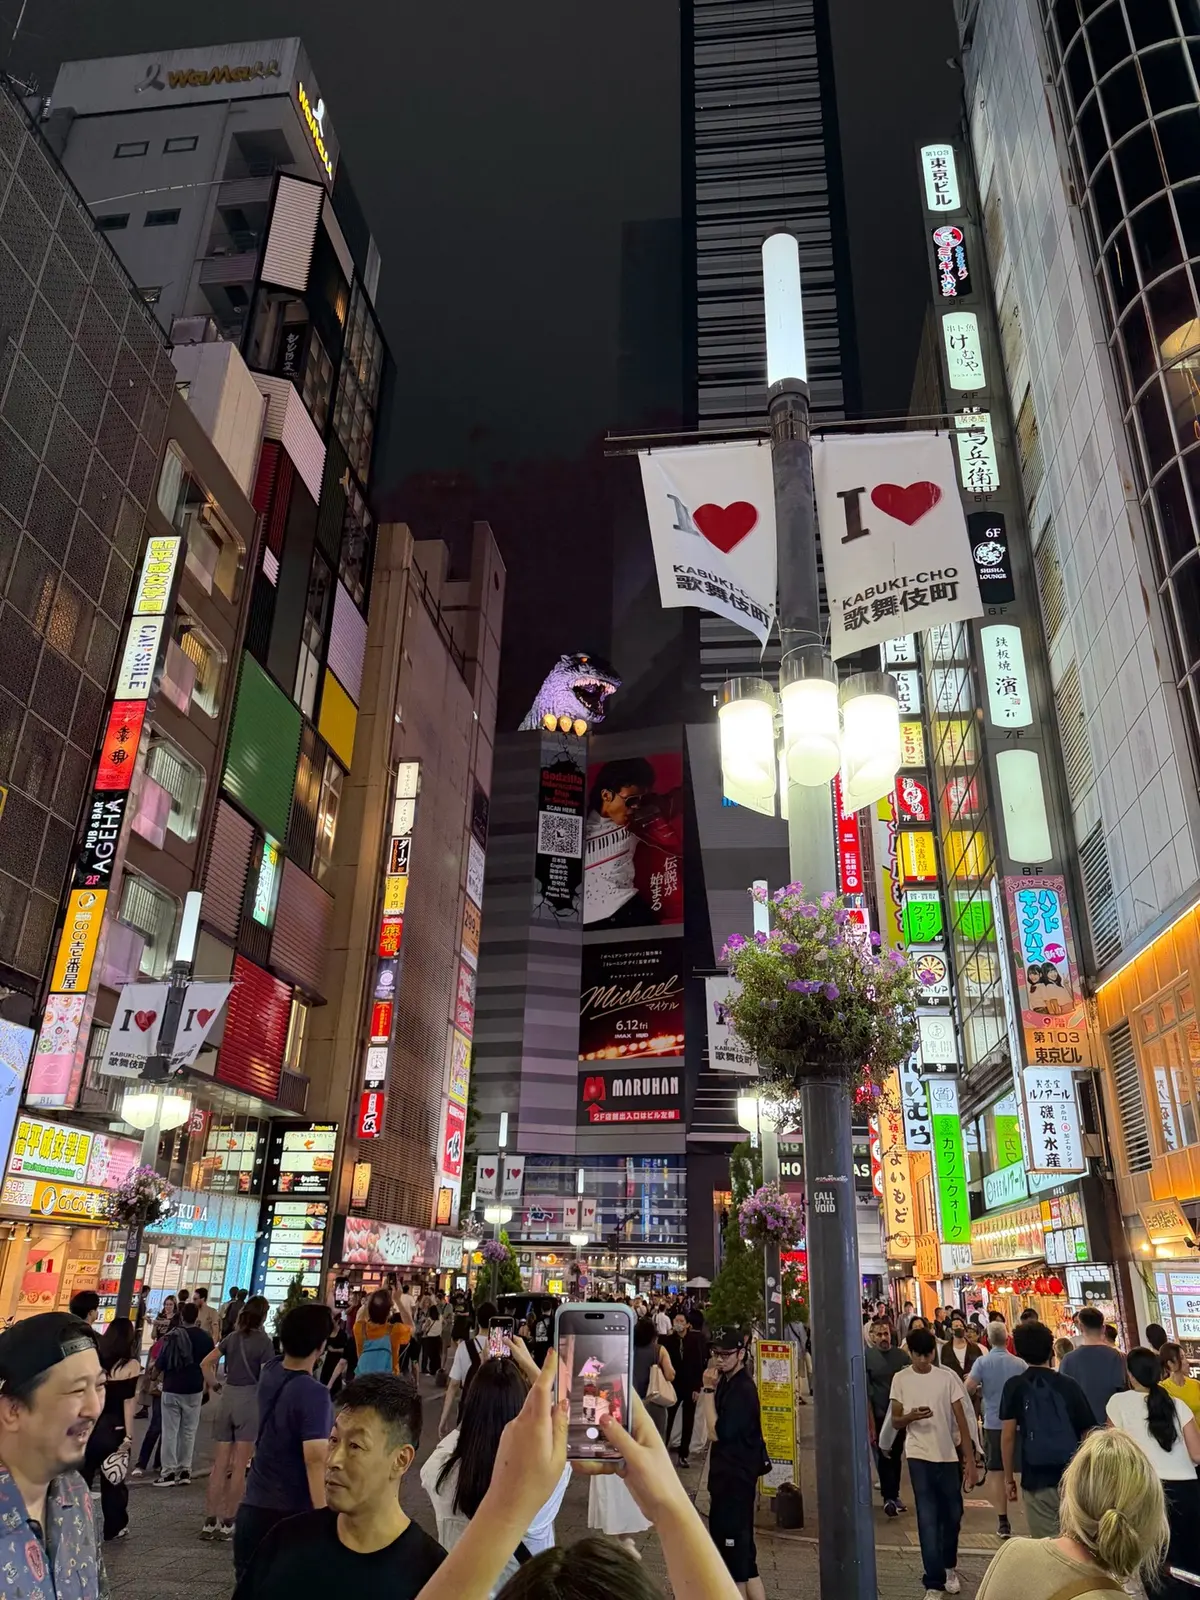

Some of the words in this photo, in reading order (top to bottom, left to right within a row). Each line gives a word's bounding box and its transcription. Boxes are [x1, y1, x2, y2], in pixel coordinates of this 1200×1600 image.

[929, 158, 953, 206] 東京ビル
[961, 391, 979, 399] 4F
[836, 486, 872, 545] I
[985, 528, 1001, 537] 6F
[842, 566, 959, 611] KABUKI-CHO
[675, 574, 771, 630] 歌舞伎町
[843, 580, 960, 632] 歌舞伎町
[988, 607, 1008, 615] 6F
[996, 636, 1012, 671] 鉄板焼
[1004, 730, 1024, 739] 7F
[542, 770, 583, 785] Godzilla
[92, 801, 104, 820] BAR
[546, 804, 561, 812] SCAN
[562, 806, 577, 814] HERE
[91, 820, 100, 828] &
[85, 830, 98, 849] PUB
[92, 798, 124, 874] AGEHA
[397, 839, 409, 867] ダーツ
[550, 862, 569, 870] English
[1022, 867, 1044, 876] 8F
[85, 874, 101, 886] 2F
[663, 857, 679, 897] 伝説が
[649, 873, 663, 912] 始まる
[1038, 889, 1060, 934] ハンド
[380, 923, 401, 952] 麻雀
[1044, 947, 1066, 960] 新宿
[580, 974, 685, 1018] Michael
[927, 997, 940, 1006] 4F
[645, 1002, 680, 1011] マイケル
[119, 1009, 135, 1031] I
[183, 1008, 198, 1031] I
[615, 1019, 638, 1031] 6.12
[639, 1022, 648, 1030] fri
[1033, 1031, 1080, 1044] 第103
[1034, 1047, 1083, 1064] 東京ビル
[935, 1063, 947, 1072] 3F
[612, 1076, 679, 1097] MARUHAN
[1030, 1089, 1071, 1101] ルノアール
[1040, 1105, 1062, 1168] 磯丸水産
[480, 1167, 484, 1179] I
[506, 1168, 511, 1180] I
[814, 1191, 835, 1200] CALL
[942, 1138, 964, 1238] カワノ・クォーク
[815, 1204, 836, 1213] VOID
